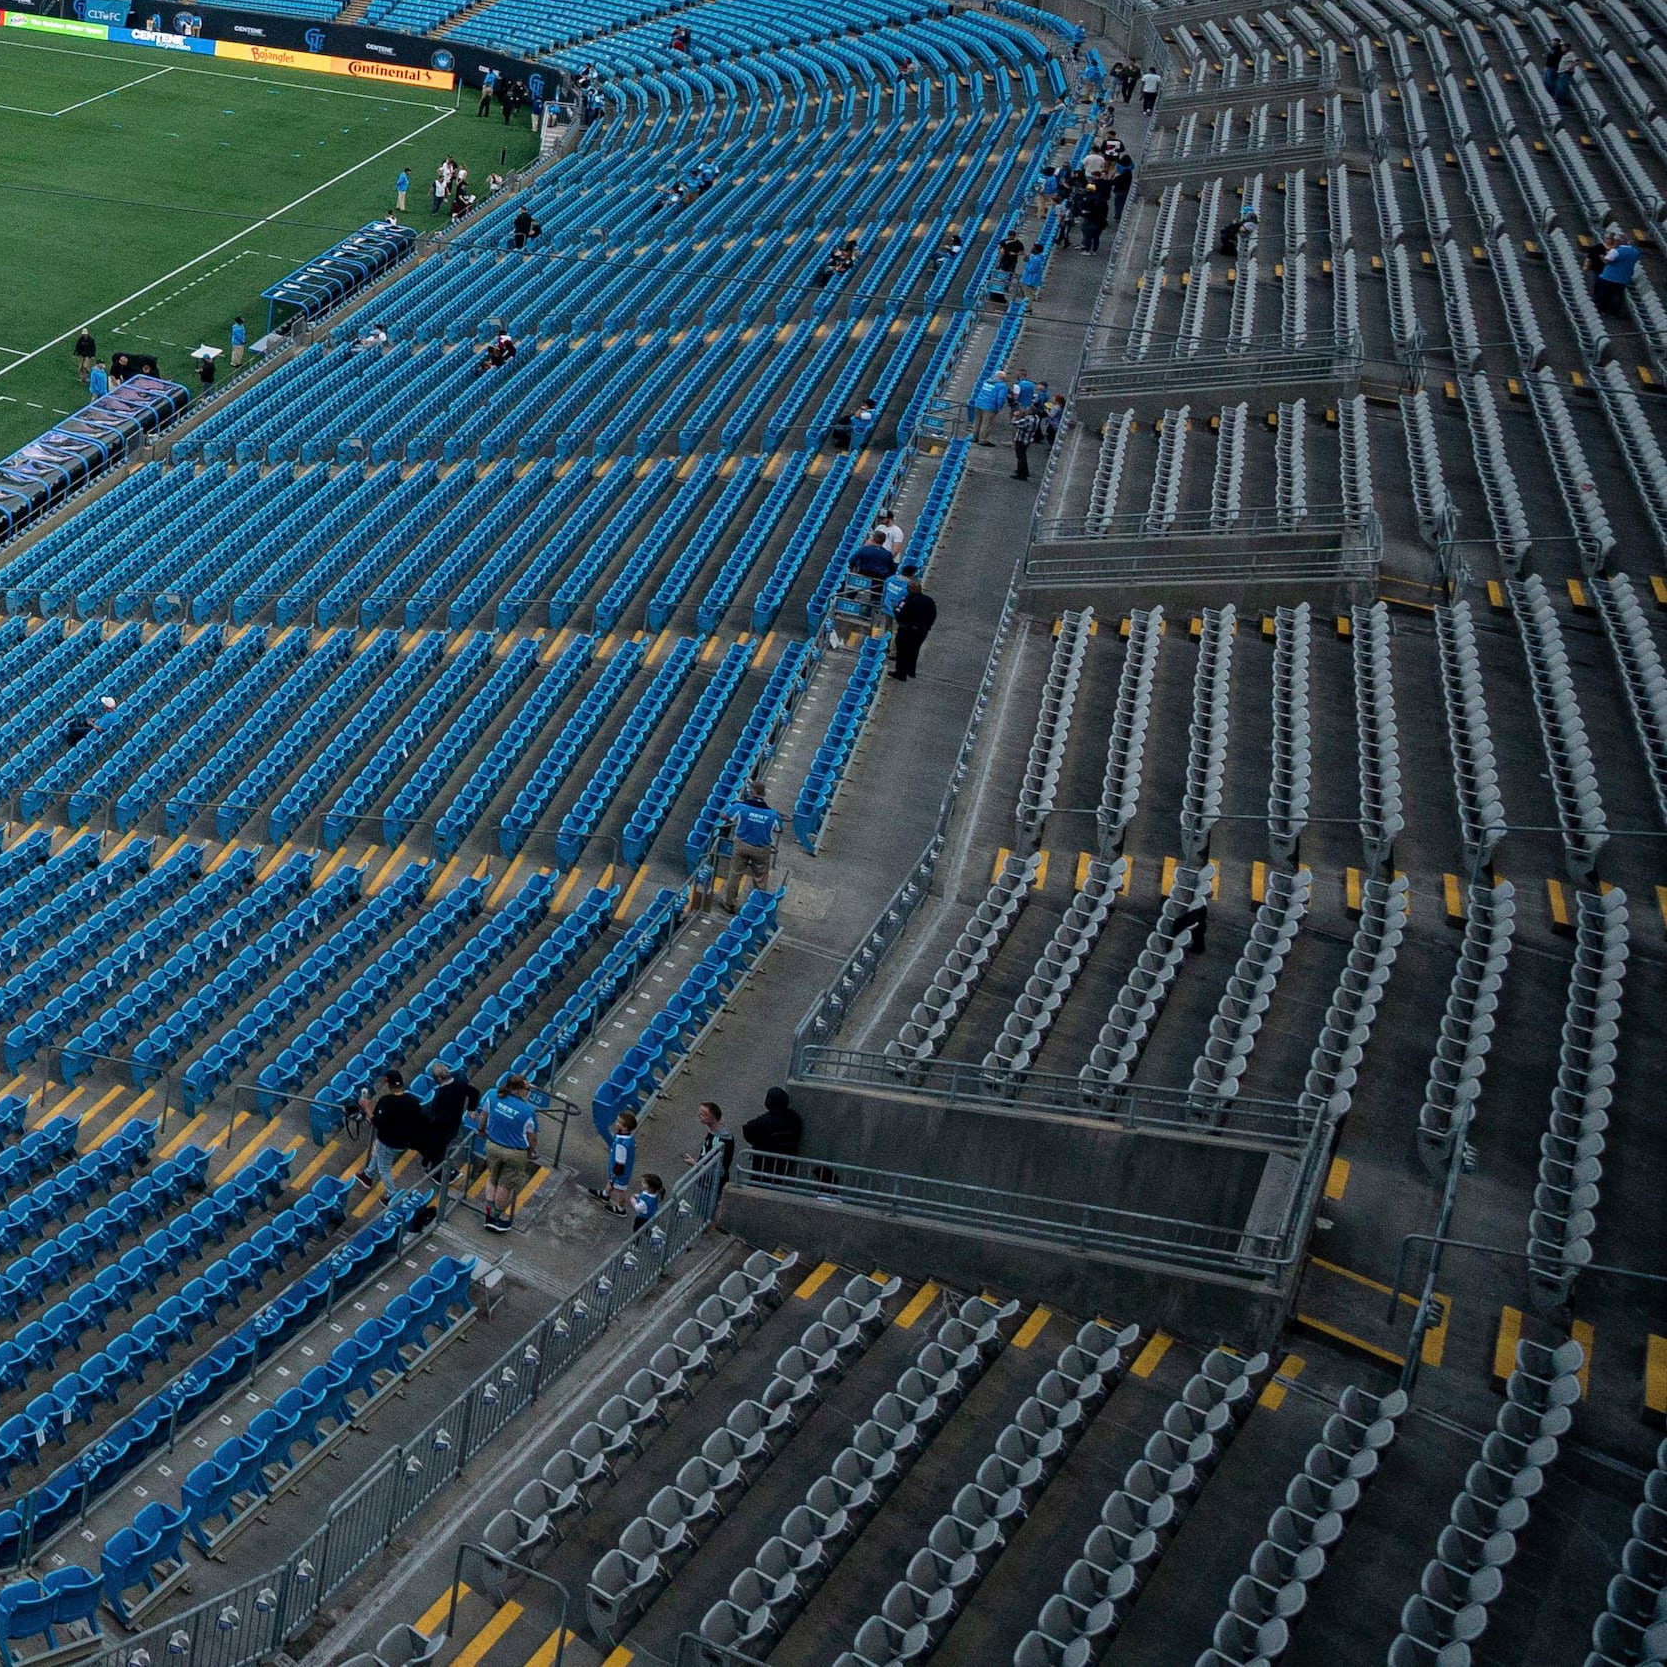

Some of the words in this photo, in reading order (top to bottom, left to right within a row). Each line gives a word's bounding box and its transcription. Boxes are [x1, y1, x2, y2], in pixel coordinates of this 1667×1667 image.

[132, 28, 186, 46] CENTENE
[251, 46, 295, 64] Bojangles
[348, 60, 421, 82] Continental
